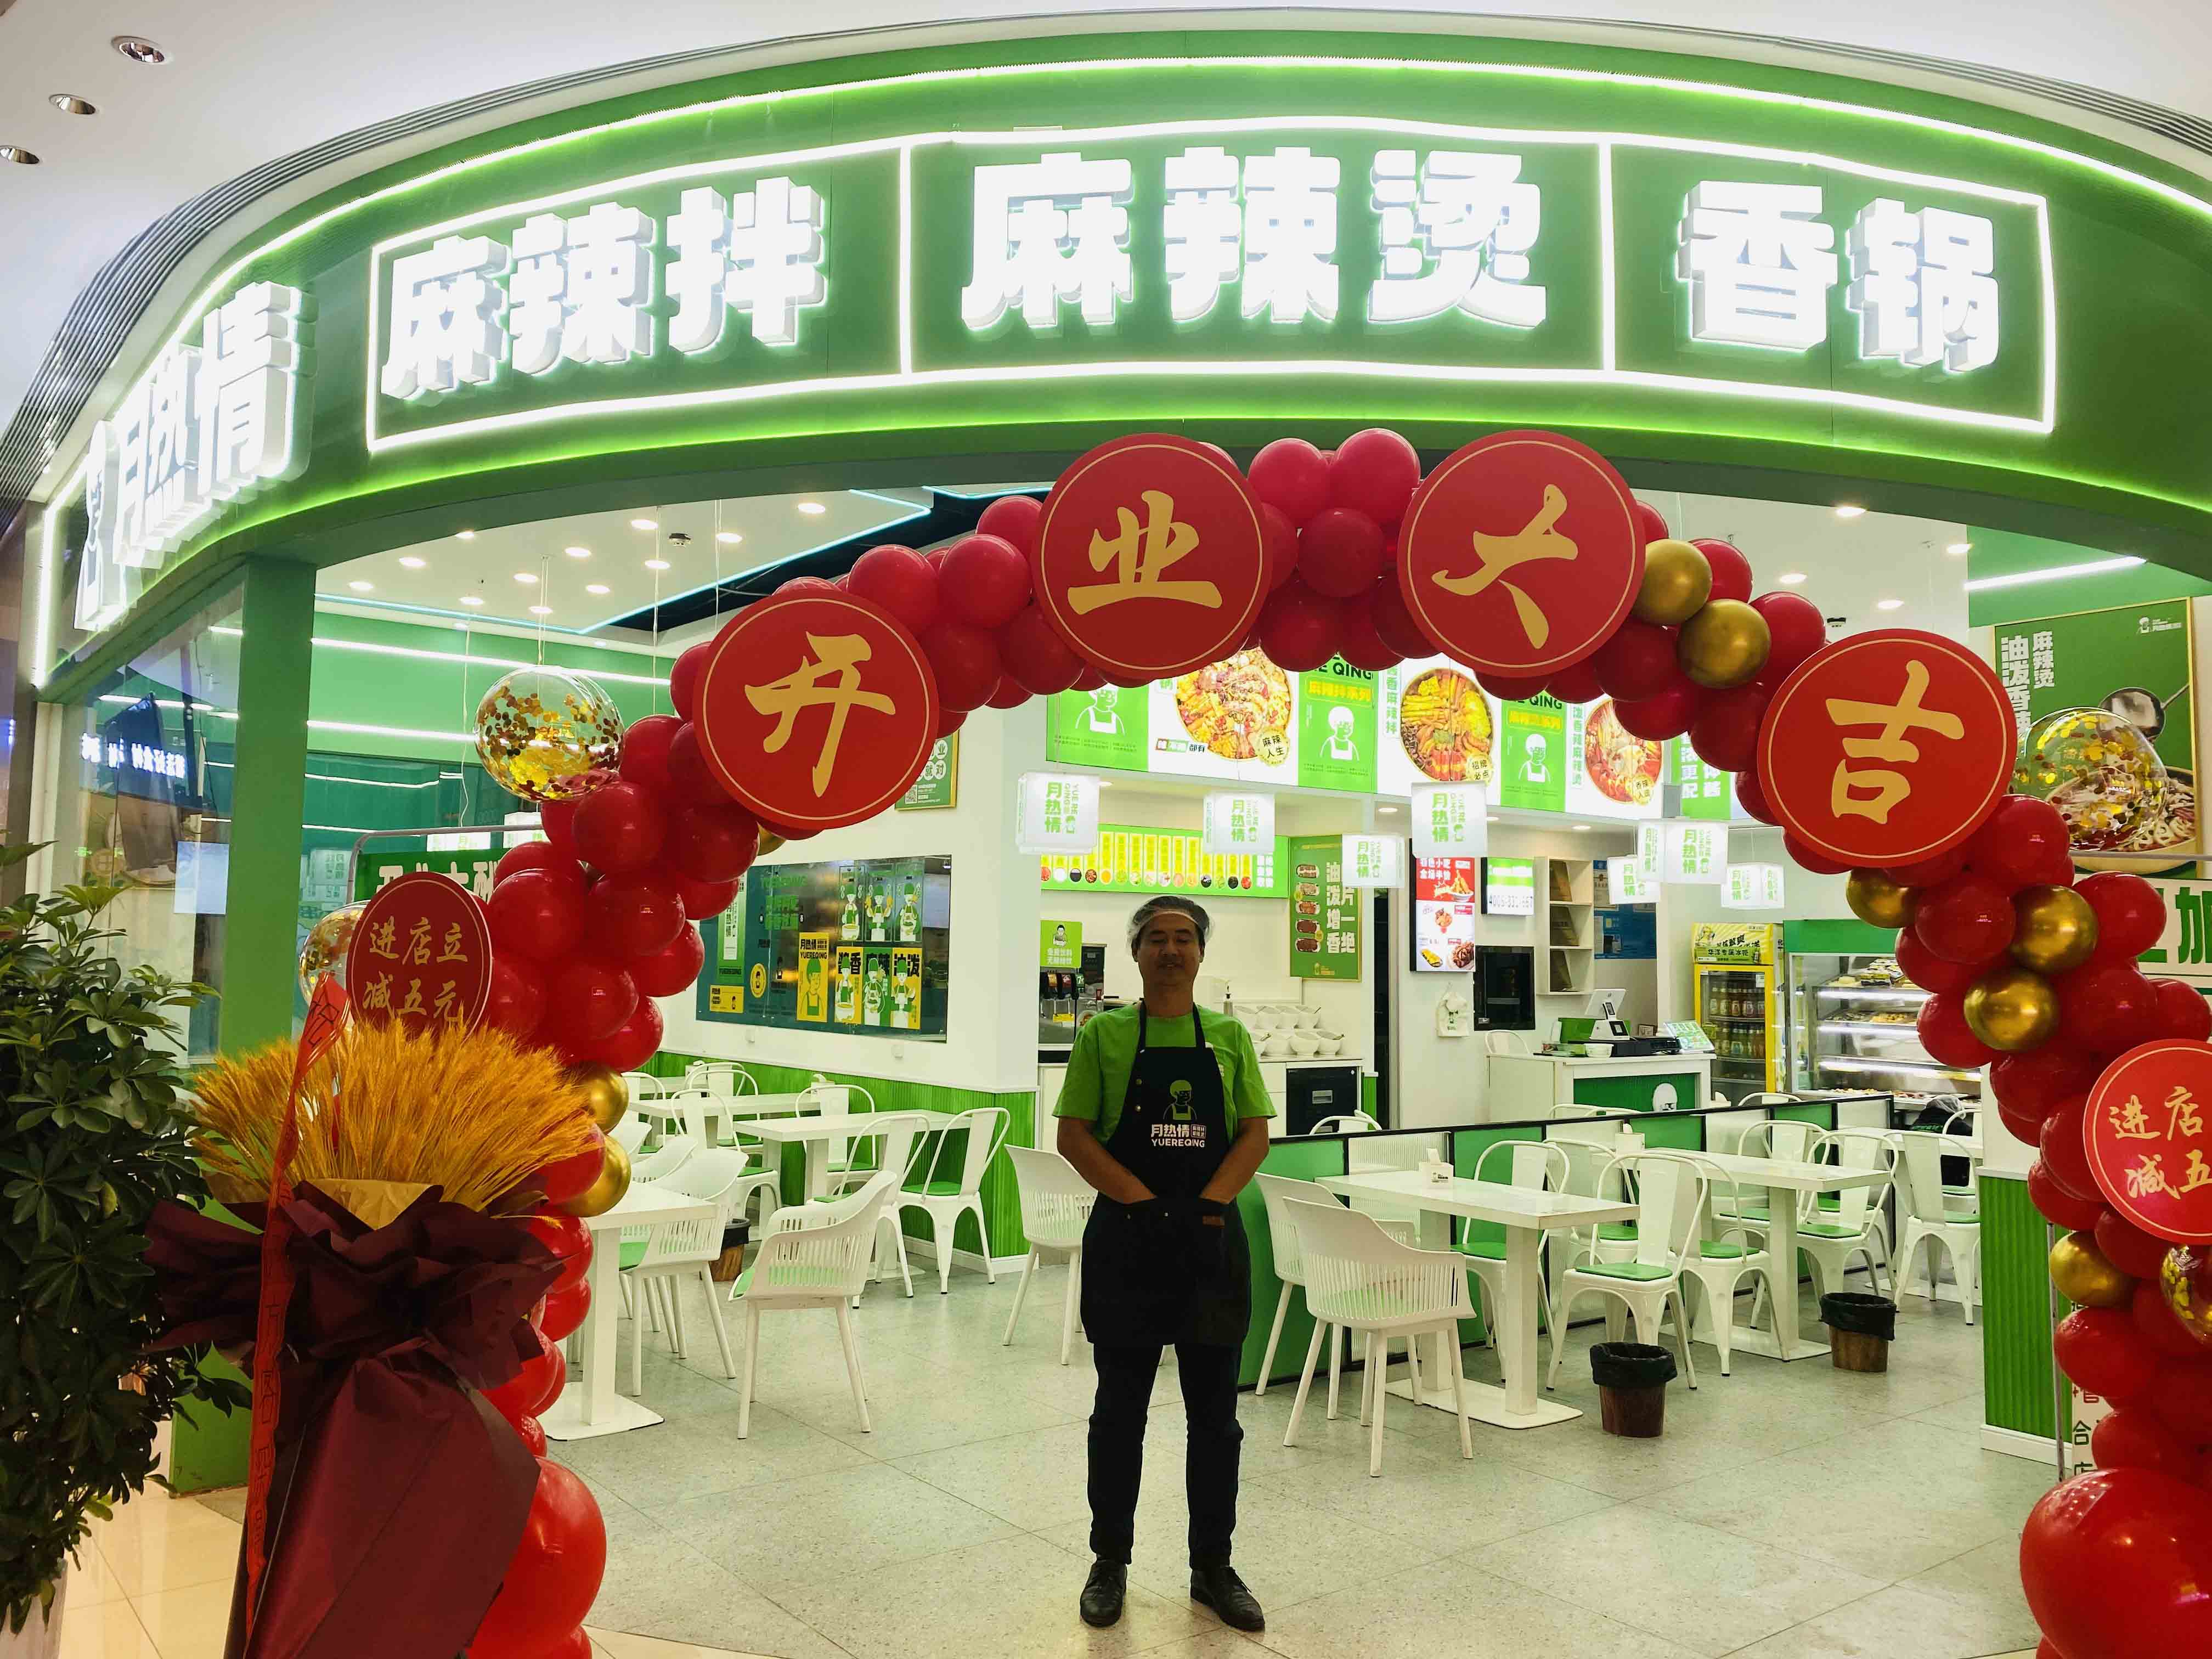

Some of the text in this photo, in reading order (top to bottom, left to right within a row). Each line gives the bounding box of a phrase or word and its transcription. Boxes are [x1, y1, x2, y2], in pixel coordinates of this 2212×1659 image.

[961, 148, 1546, 330] 麻辣烫
[381, 176, 825, 401] 麻辣拌
[1677, 180, 2000, 374] 香锅
[1068, 490, 1223, 615] 业
[1432, 484, 1578, 649] 大
[2032, 631, 2054, 689] 麻辣烫
[744, 631, 896, 798] 开
[1825, 660, 1965, 825] 吉
[1045, 781, 1063, 833] 月热情
[1231, 799, 1245, 842] 月热情
[1432, 793, 1449, 843] 月热情
[1681, 829, 1697, 874] 月热情
[369, 915, 468, 966] 进店立
[362, 970, 461, 1022] 减五元
[1151, 1124, 1190, 1138] 月热情
[2108, 1085, 2204, 1141] 进店
[1152, 1138, 1205, 1148] YUEREQING
